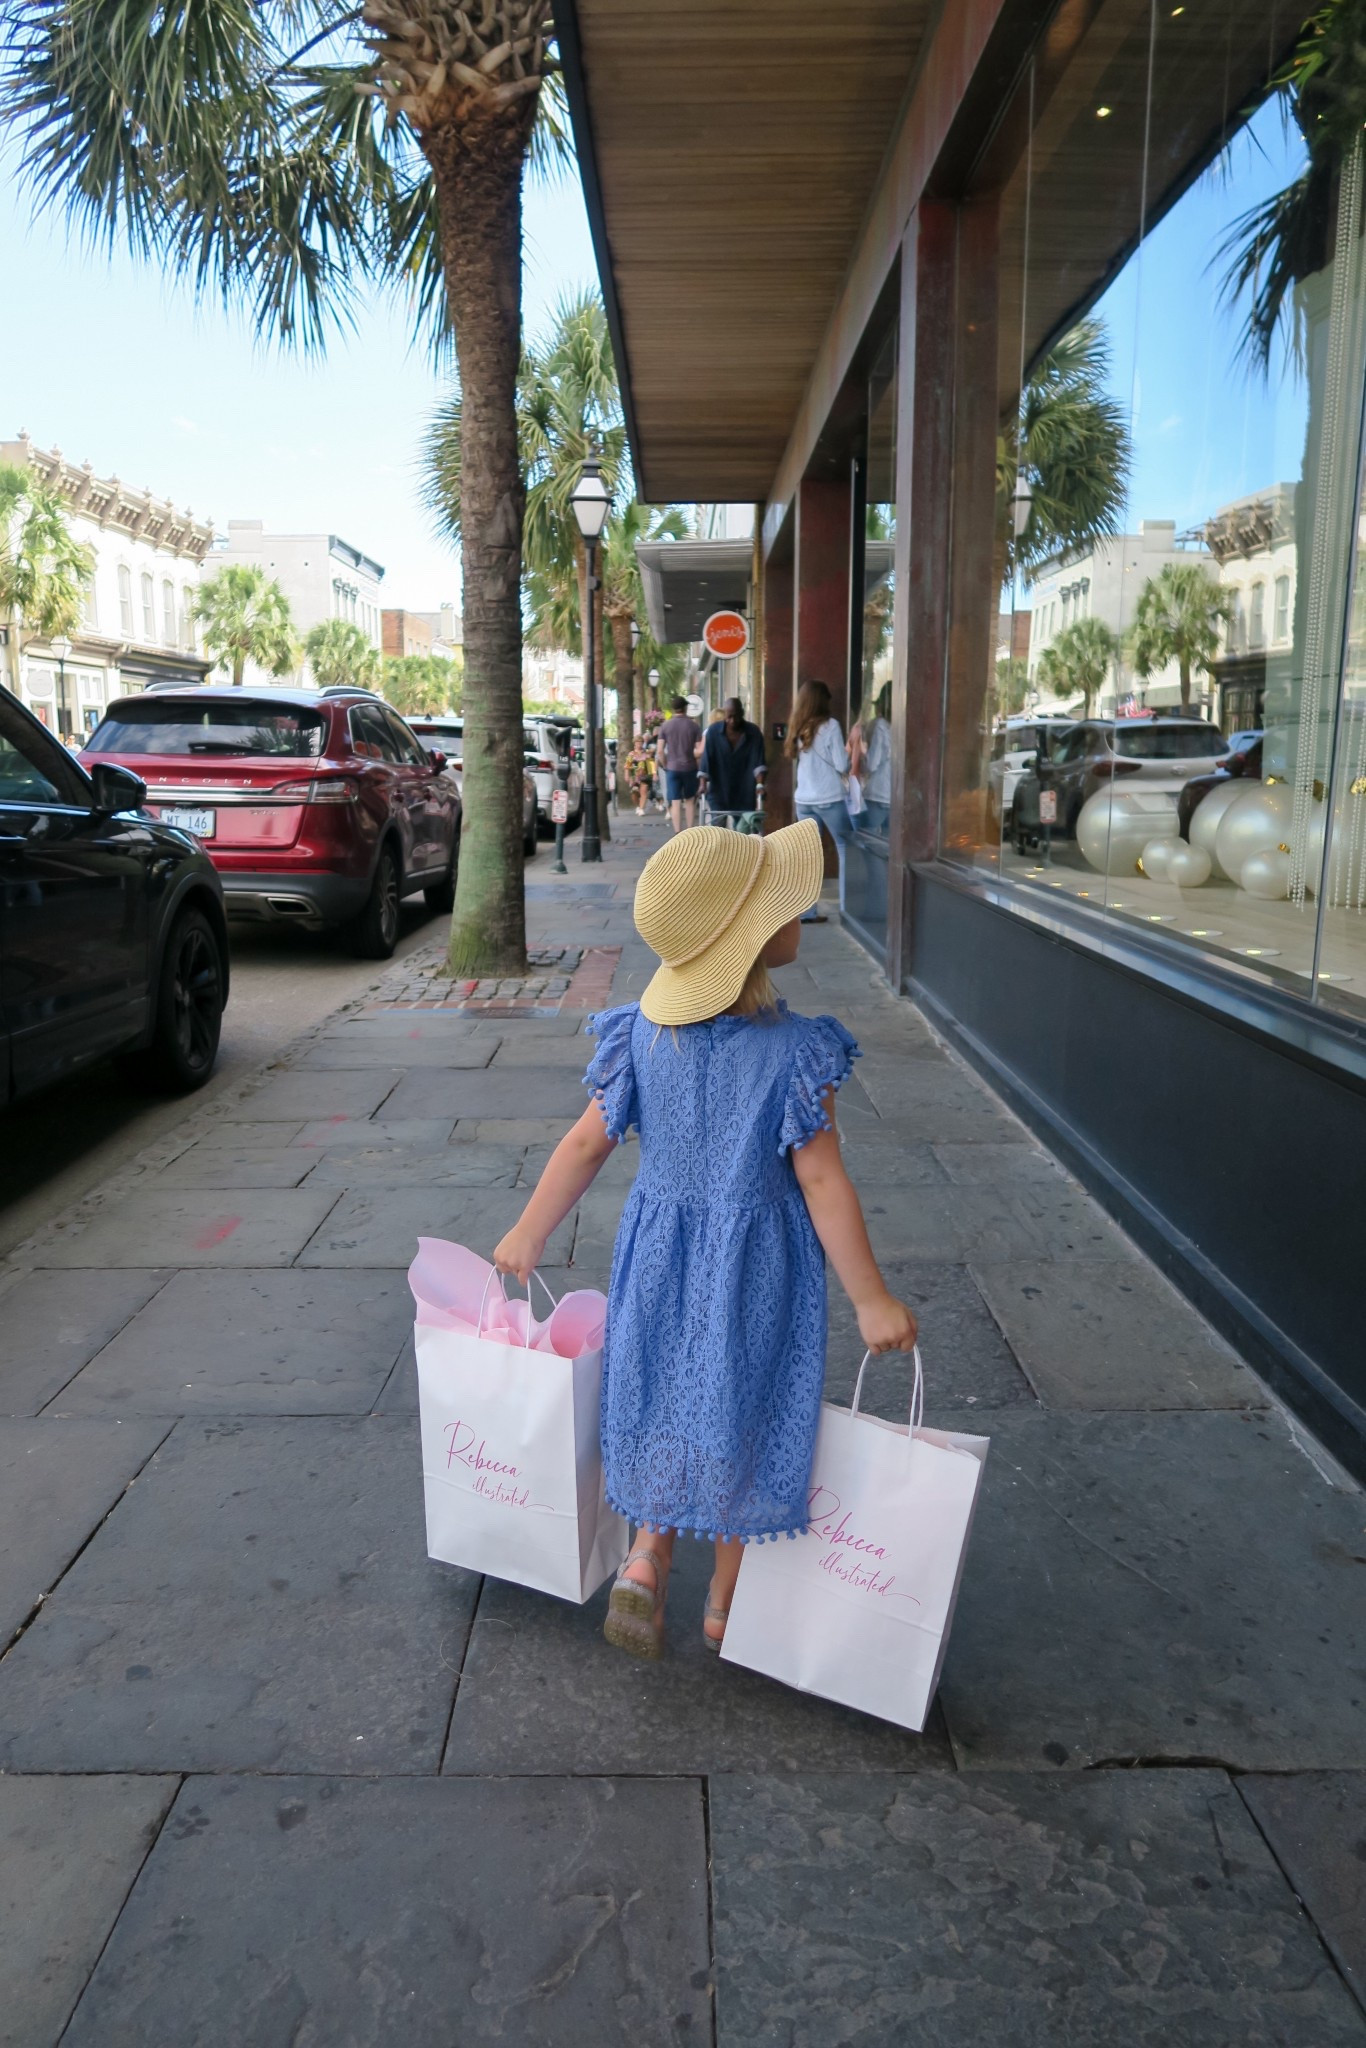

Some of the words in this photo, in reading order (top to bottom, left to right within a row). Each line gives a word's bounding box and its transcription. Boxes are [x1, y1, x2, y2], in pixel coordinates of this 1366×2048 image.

[141, 776, 252, 785] INCOLN
[187, 815, 207, 829] 146
[443, 1420, 522, 1478] Rebecca
[472, 1476, 554, 1511] illustrated
[806, 1485, 892, 1560] Rebecca
[818, 1551, 921, 1606] illustrated
